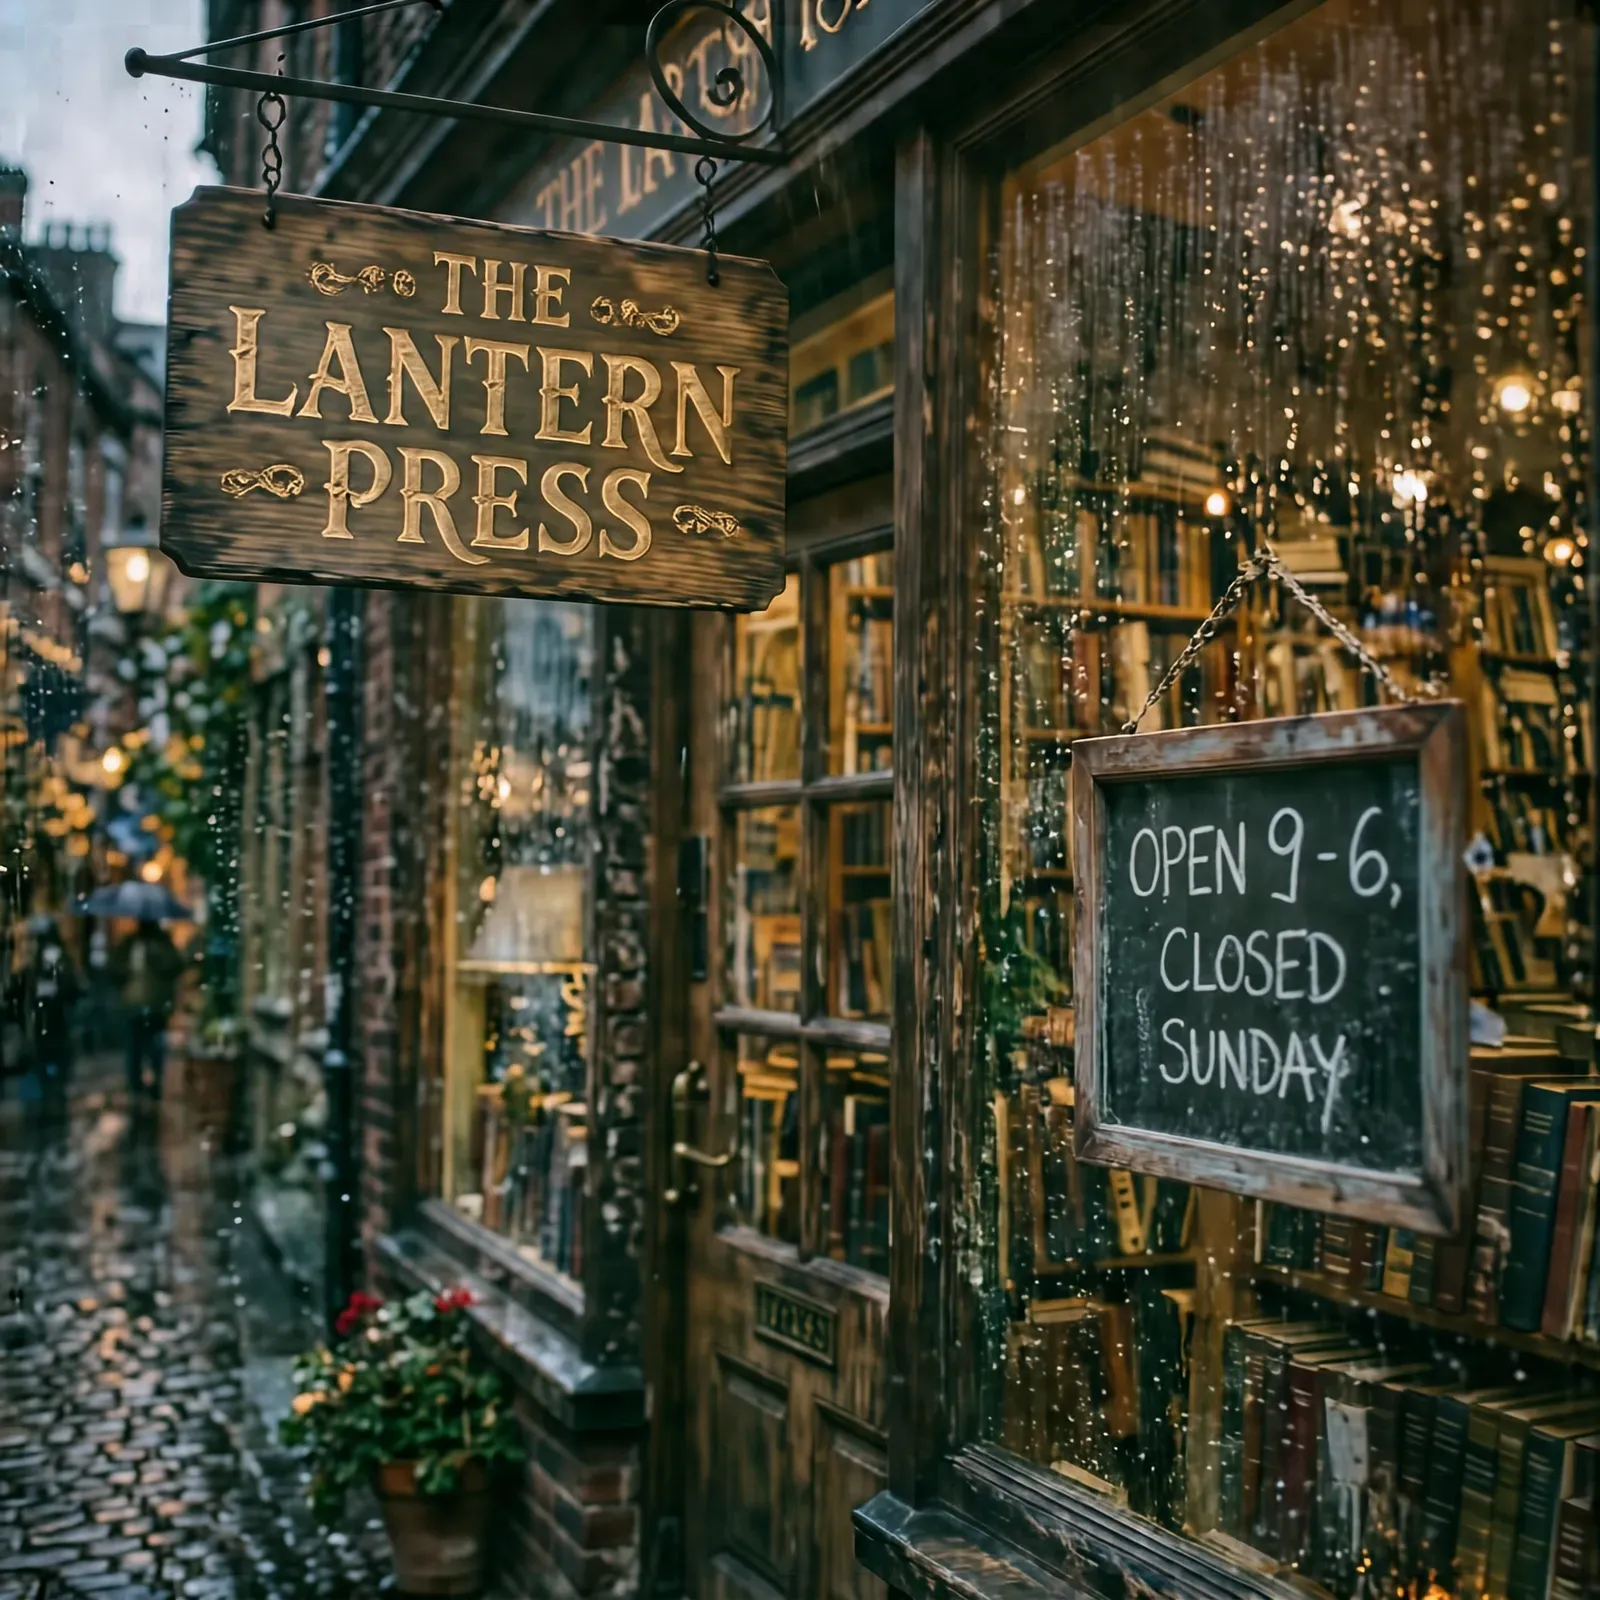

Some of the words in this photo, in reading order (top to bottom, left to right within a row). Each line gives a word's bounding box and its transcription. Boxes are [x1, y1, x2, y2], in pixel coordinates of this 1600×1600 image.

[433, 251, 572, 328] THE
[226, 305, 741, 473] LANTERN
[321, 439, 653, 565] PRESS
[1129, 822, 1246, 897] OPEN
[1160, 927, 1347, 1003] CLOSED
[1159, 1018, 1348, 1134] SUNDAY
